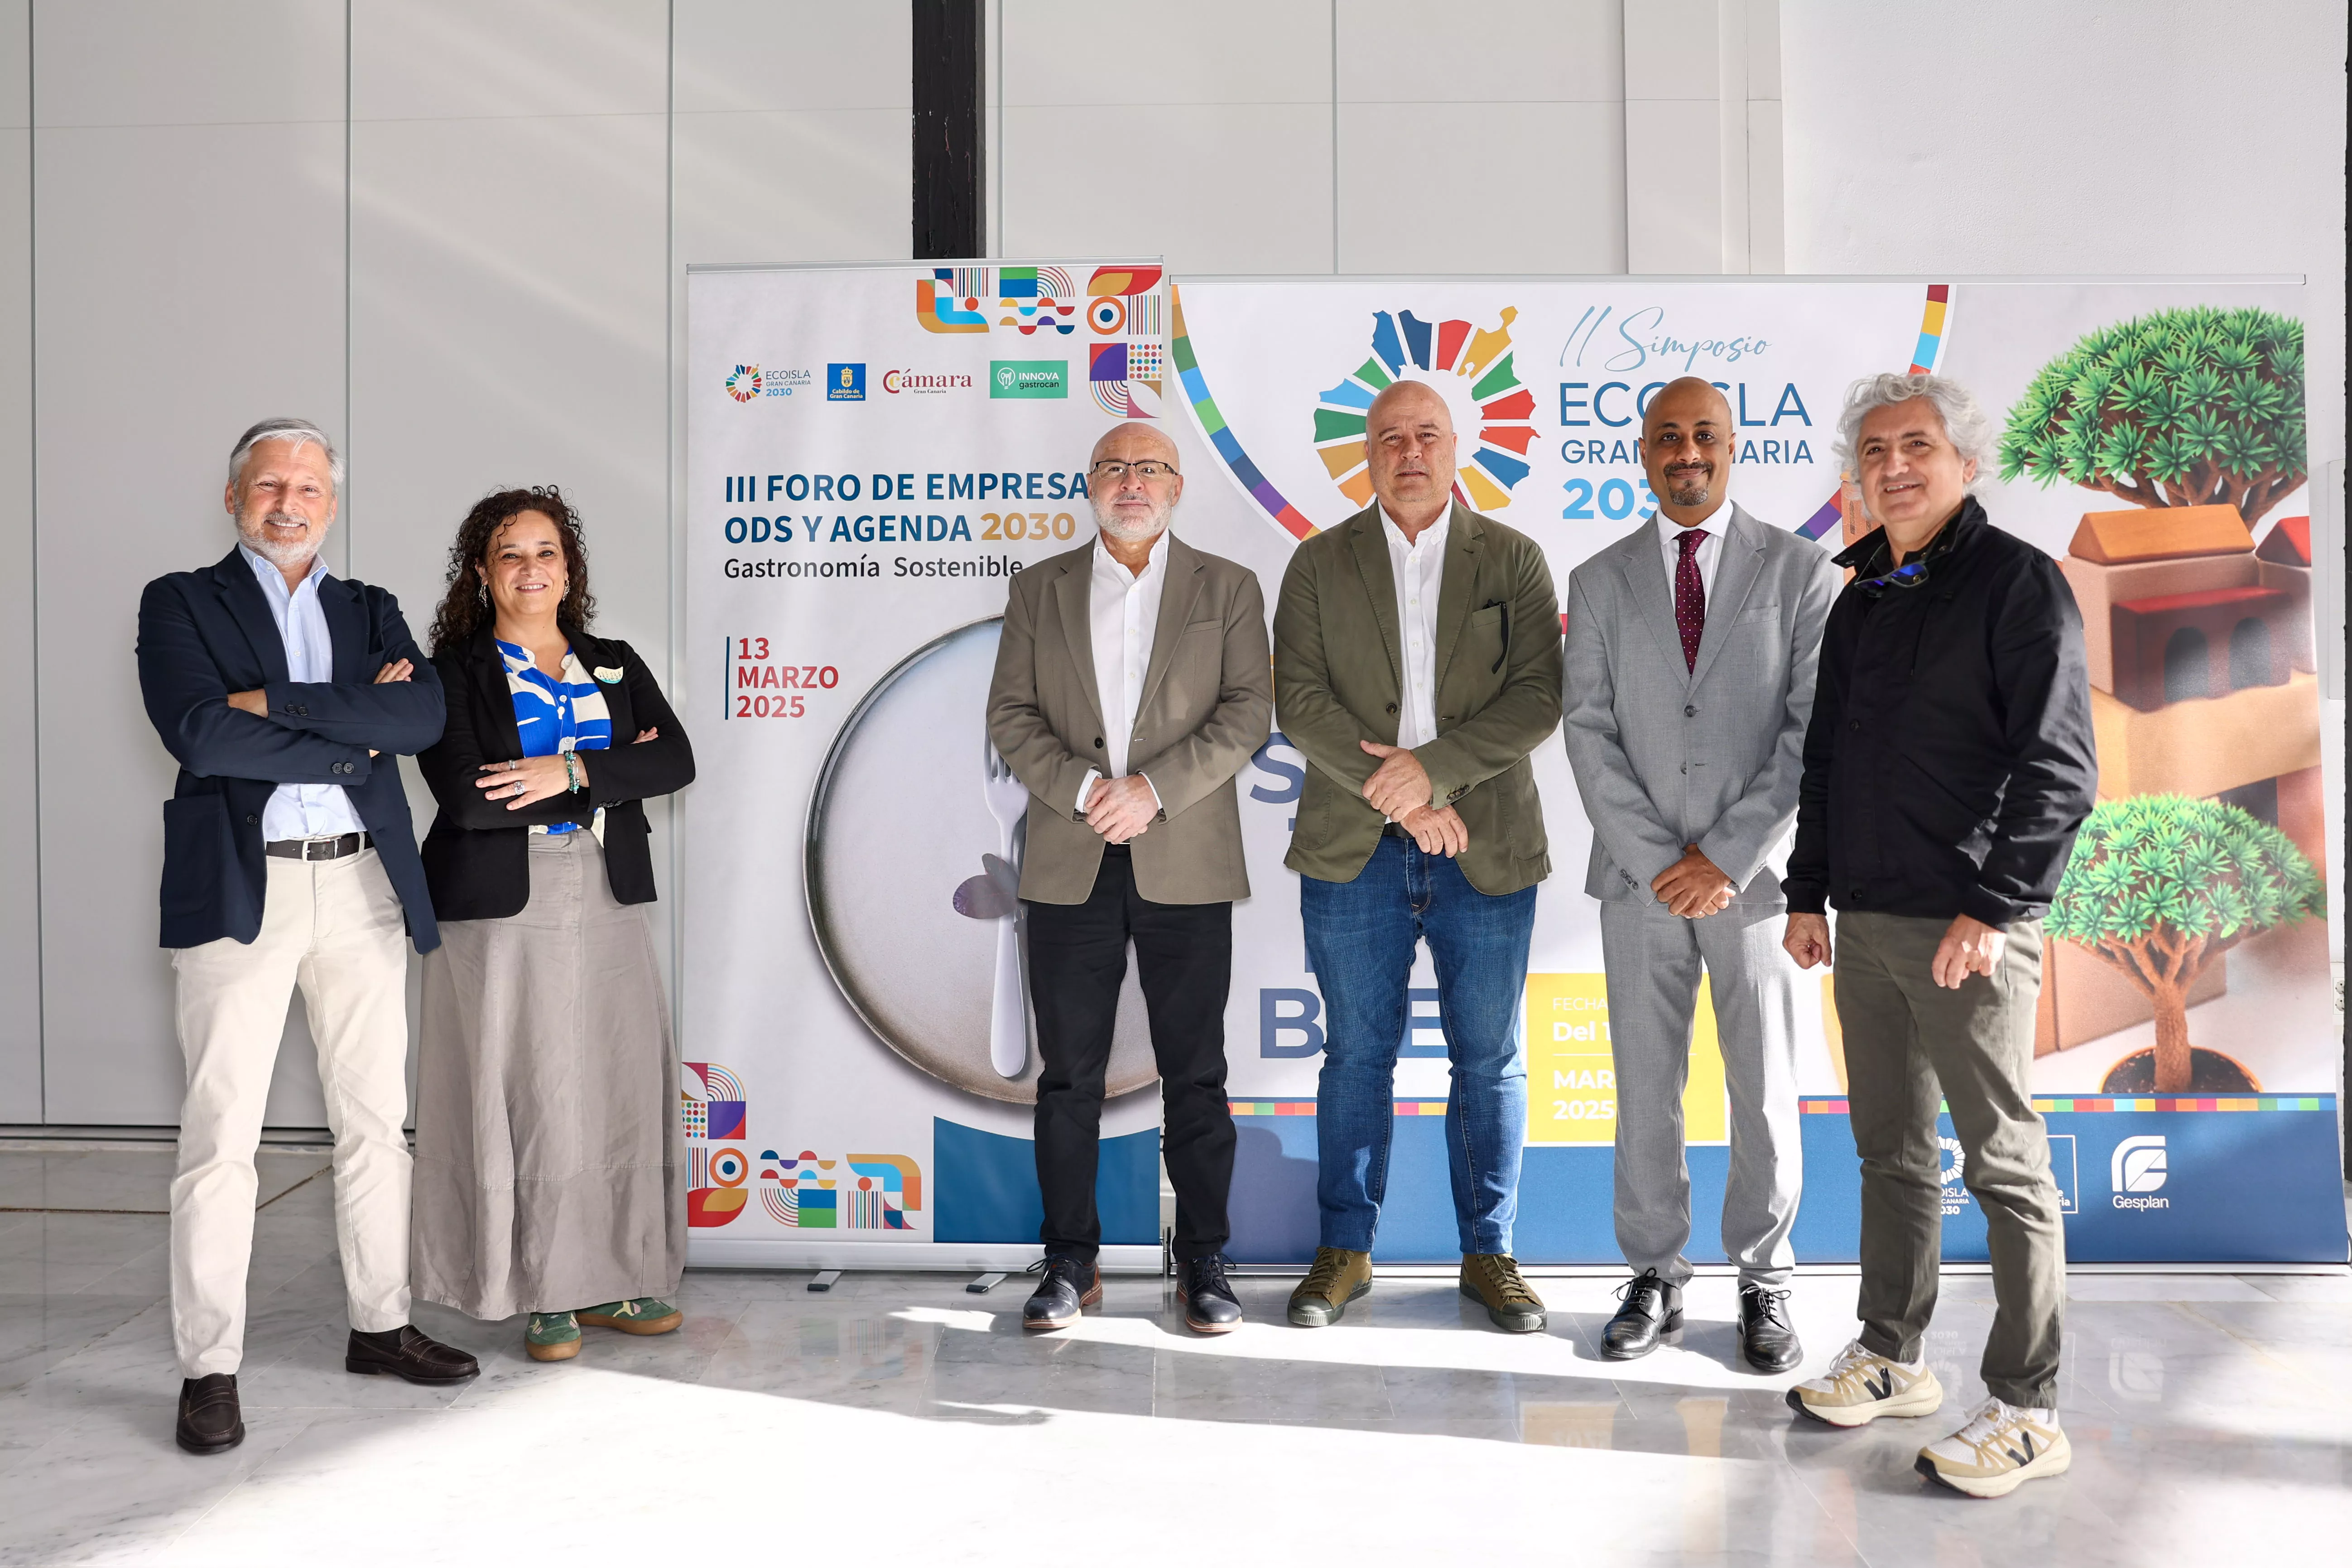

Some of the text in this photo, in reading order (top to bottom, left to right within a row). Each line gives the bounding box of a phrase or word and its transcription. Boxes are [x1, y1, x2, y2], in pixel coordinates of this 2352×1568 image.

[1559, 305, 1773, 373] II Simposio
[766, 369, 811, 380] ECOISLA
[1019, 372, 1059, 380] INNOVA
[766, 387, 793, 397] 2030
[1019, 382, 1059, 390] gastrocan
[726, 476, 755, 502] III
[768, 474, 861, 501] FORO
[872, 473, 915, 500] DE
[725, 512, 1076, 544] ODS Y AGENDA 2030
[725, 553, 1023, 578] Gastronomía Sostenible
[738, 637, 770, 660] 13
[738, 666, 839, 689] MARZO
[736, 695, 805, 718] 2025
[1553, 1021, 1596, 1041] Del
[1553, 1100, 1615, 1120] 2025
[1940, 1206, 1960, 1215] 030
[2112, 1195, 2169, 1212] Gesplan
